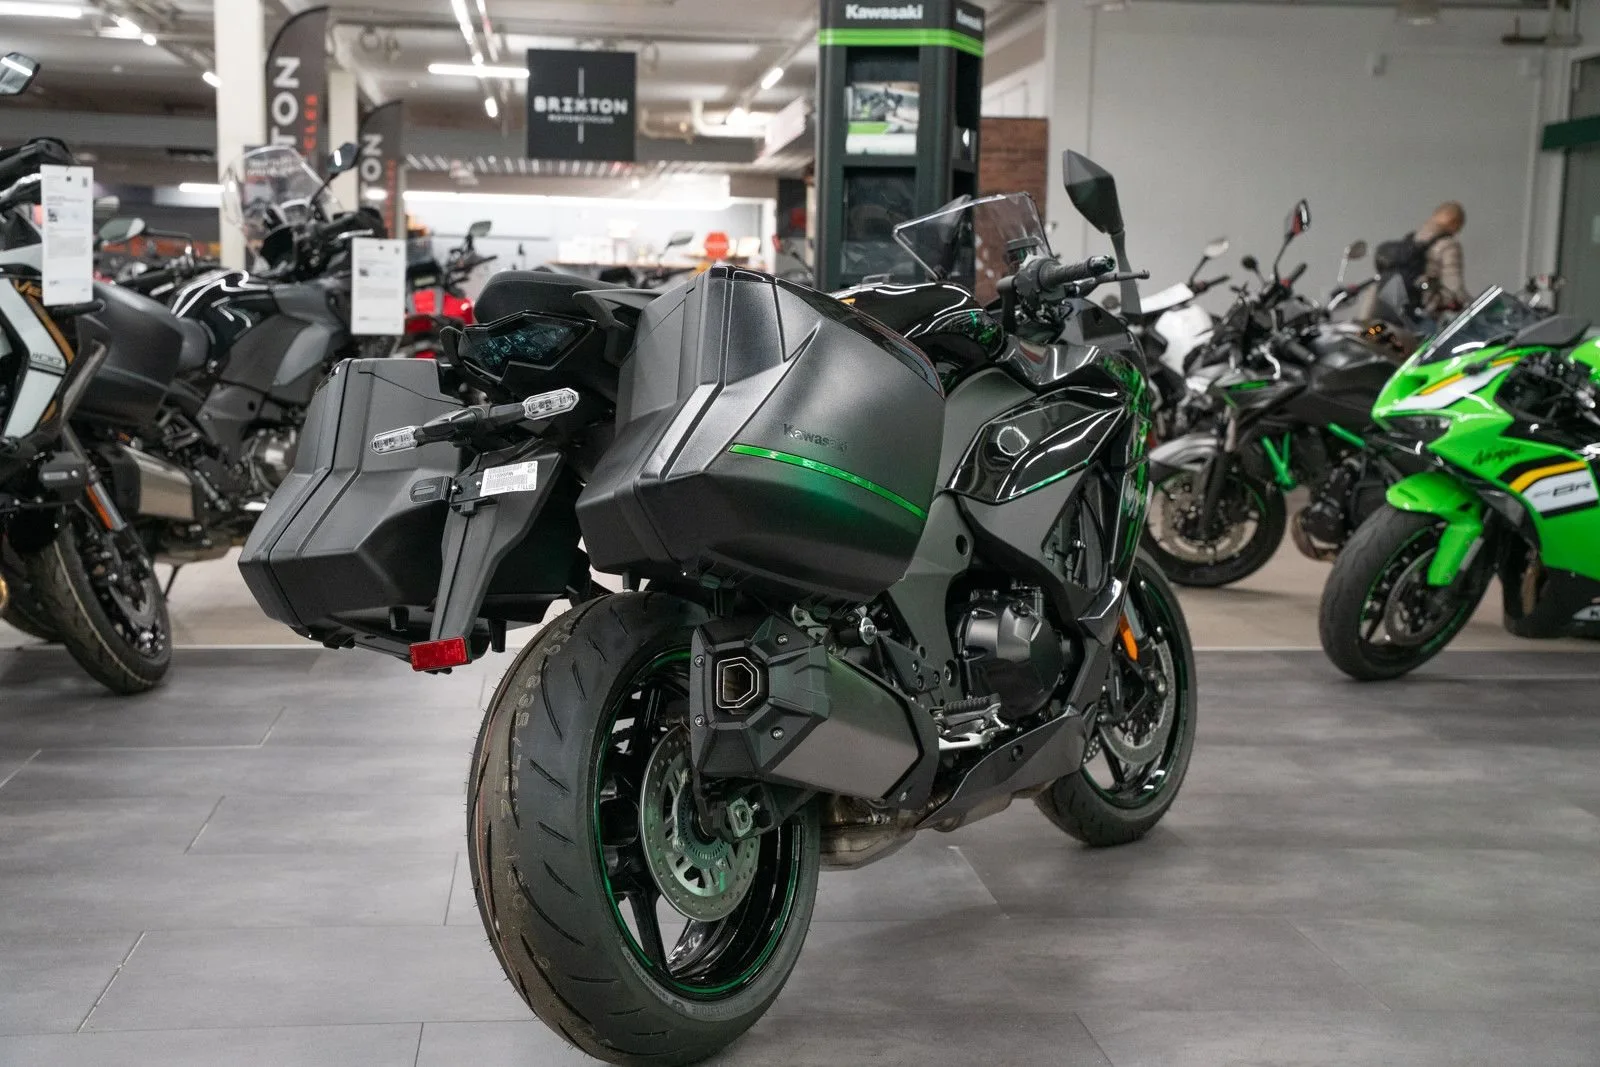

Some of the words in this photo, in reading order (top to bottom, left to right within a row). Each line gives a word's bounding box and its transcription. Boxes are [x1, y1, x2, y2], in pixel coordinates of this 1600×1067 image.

[845, 4, 924, 20] Kawasaki
[271, 57, 300, 146] TON
[533, 95, 628, 115] BRIXTON
[783, 423, 848, 451] Kawasaki
